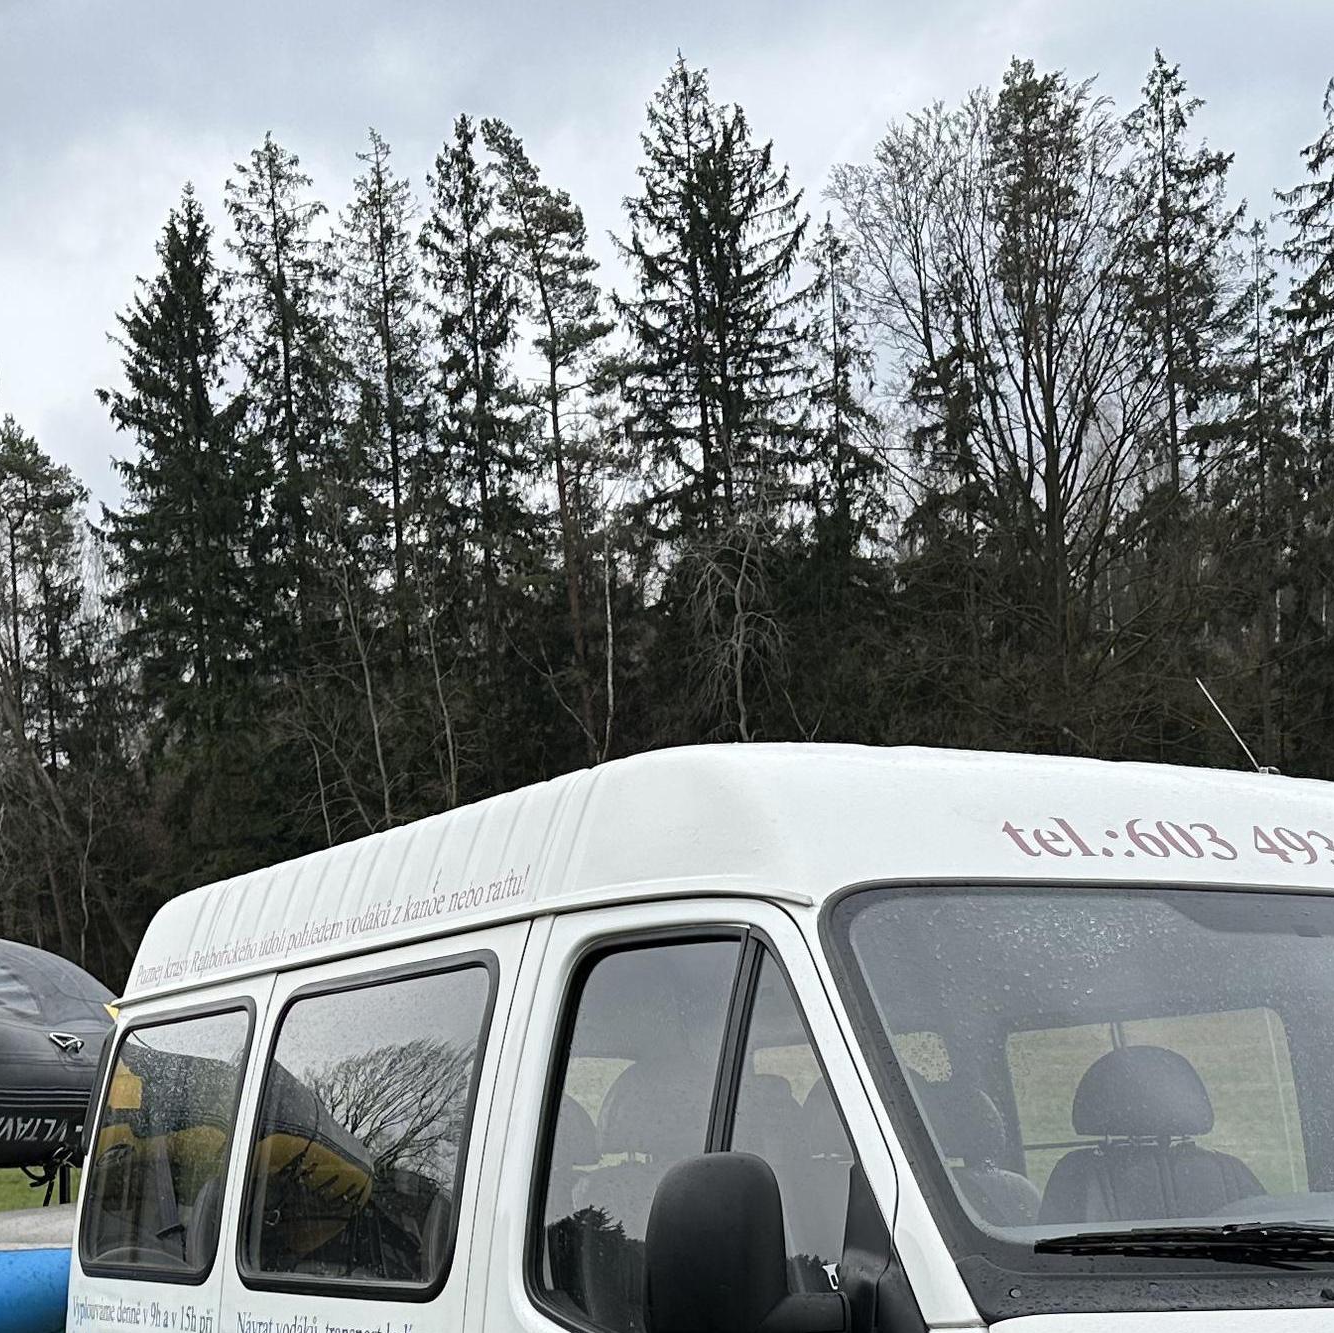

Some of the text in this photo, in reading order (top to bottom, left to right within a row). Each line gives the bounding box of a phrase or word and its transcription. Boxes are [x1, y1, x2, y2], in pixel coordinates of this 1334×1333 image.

[1001, 816, 1238, 861] tel.:603
[285, 916, 343, 959] pohledem
[345, 900, 393, 935] vodáků
[392, 904, 402, 925] z
[448, 881, 484, 914] nebo
[485, 864, 531, 904] raftu!
[116, 1298, 141, 1325] denně
[143, 1308, 148, 1324] v
[150, 1301, 161, 1328] 9h
[163, 1310, 168, 1328] a
[171, 1311, 177, 1329] v
[181, 1305, 196, 1333] 15h
